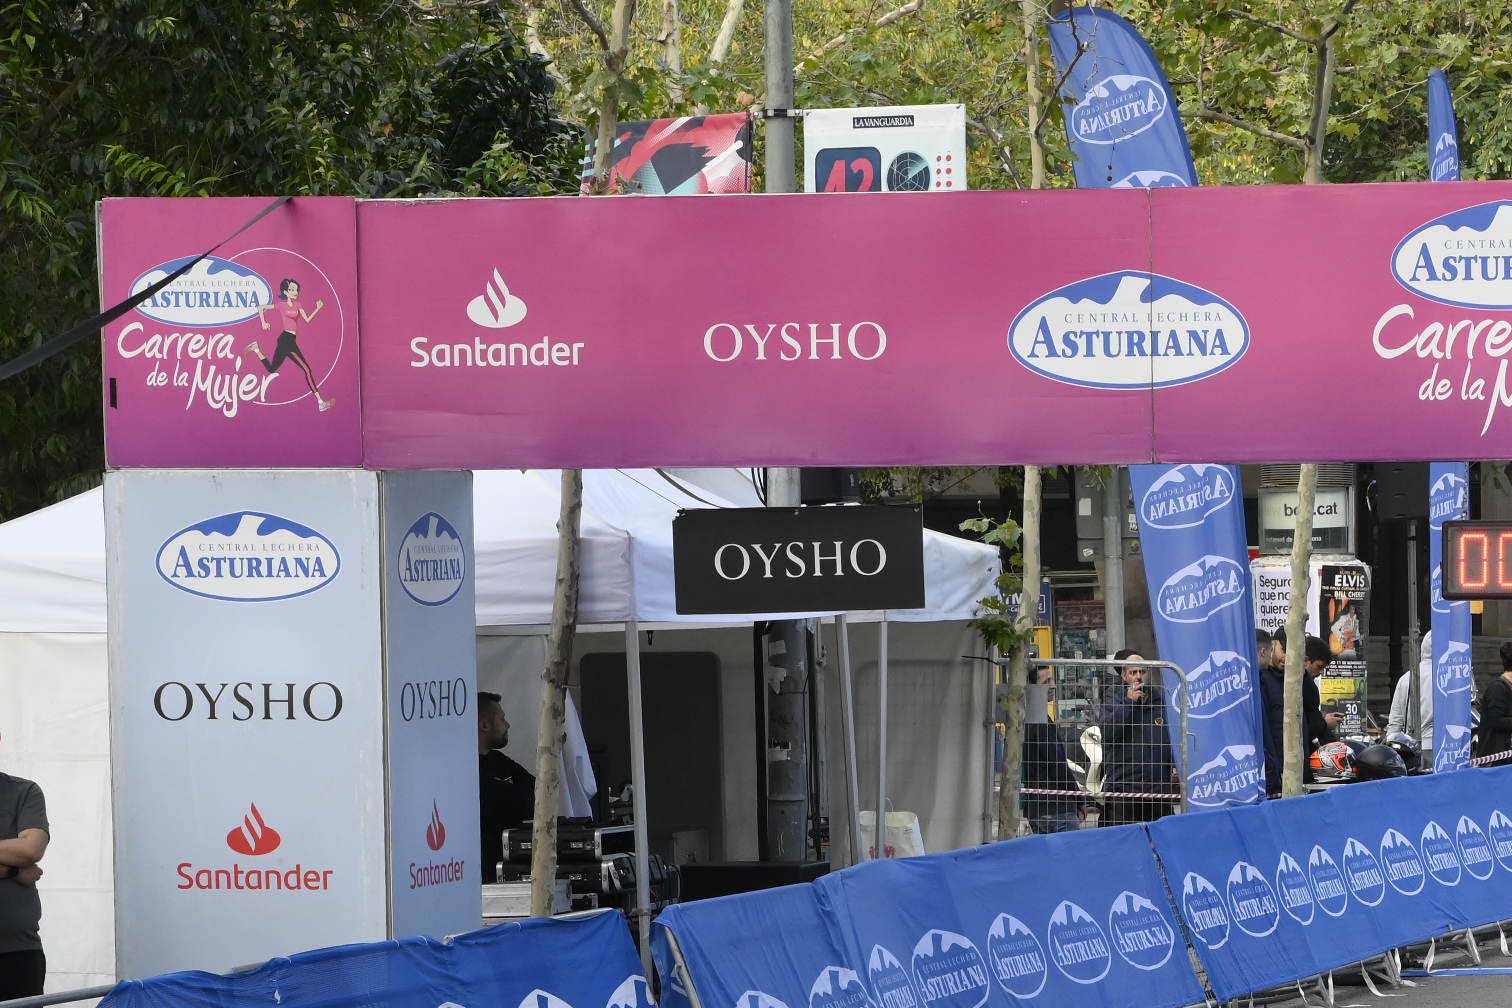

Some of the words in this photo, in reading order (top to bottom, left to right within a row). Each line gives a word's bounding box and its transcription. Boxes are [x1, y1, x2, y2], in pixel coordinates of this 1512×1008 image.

[854, 118, 866, 128] LA
[864, 117, 914, 127] VANGUARDIA
[1064, 312, 1138, 324] CENTRAL
[1147, 311, 1223, 323] LECHERA
[117, 321, 236, 360] Carrera
[410, 336, 585, 368] Santander
[704, 321, 887, 362] OYSHO
[1027, 316, 1231, 359] ASTURIANA
[146, 361, 168, 387] de
[173, 360, 188, 387] la
[186, 356, 280, 418] Mujer
[1418, 364, 1453, 401] de
[1461, 360, 1486, 401] la
[171, 545, 327, 579] ASTURIANA
[199, 543, 257, 552] CENTRAL
[263, 542, 320, 552] LECHERA
[714, 539, 887, 580] OYSHO
[404, 547, 462, 583] ASTURIANA
[1335, 574, 1365, 587] ELVIS
[1260, 591, 1276, 603] que
[153, 681, 343, 722] OYSHO
[401, 677, 467, 723] OYSHO
[176, 862, 334, 891] Santander
[410, 857, 465, 890] Santander
[993, 948, 1044, 980] ASTURIANA
[1054, 935, 1108, 966] ASTURIANA
[917, 964, 987, 1002] ASTURIANA
